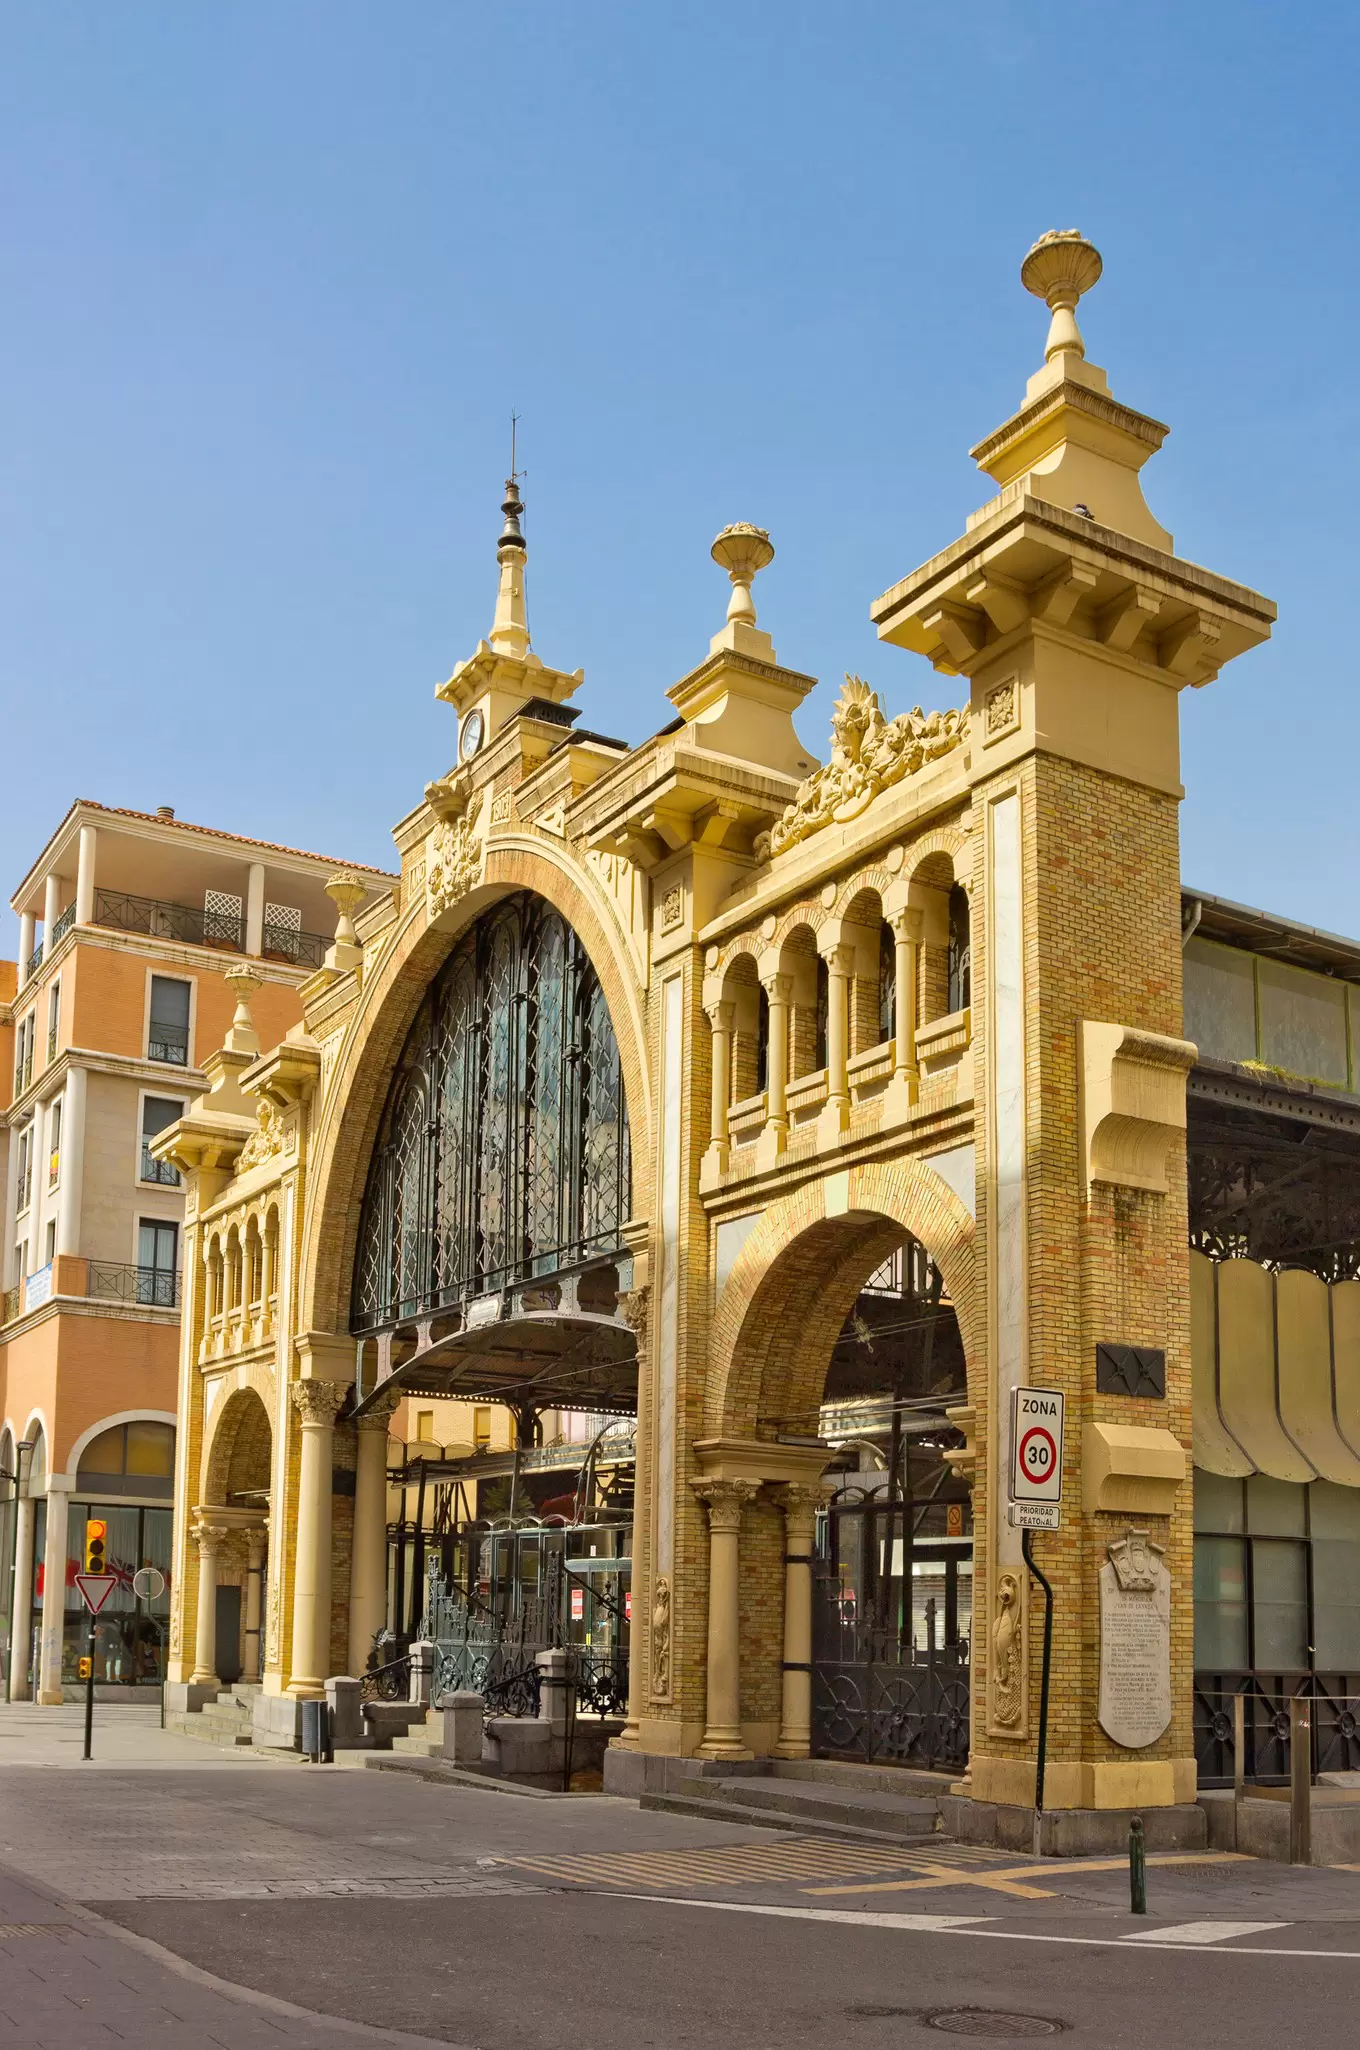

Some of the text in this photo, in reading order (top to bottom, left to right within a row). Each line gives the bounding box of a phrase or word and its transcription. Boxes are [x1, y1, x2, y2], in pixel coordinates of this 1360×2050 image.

[1022, 1399, 1057, 1416] ZONA
[1028, 1446, 1049, 1465] 30
[1020, 1506, 1053, 1516] PRIORIDAD
[1020, 1516, 1053, 1526] PEATONAL
